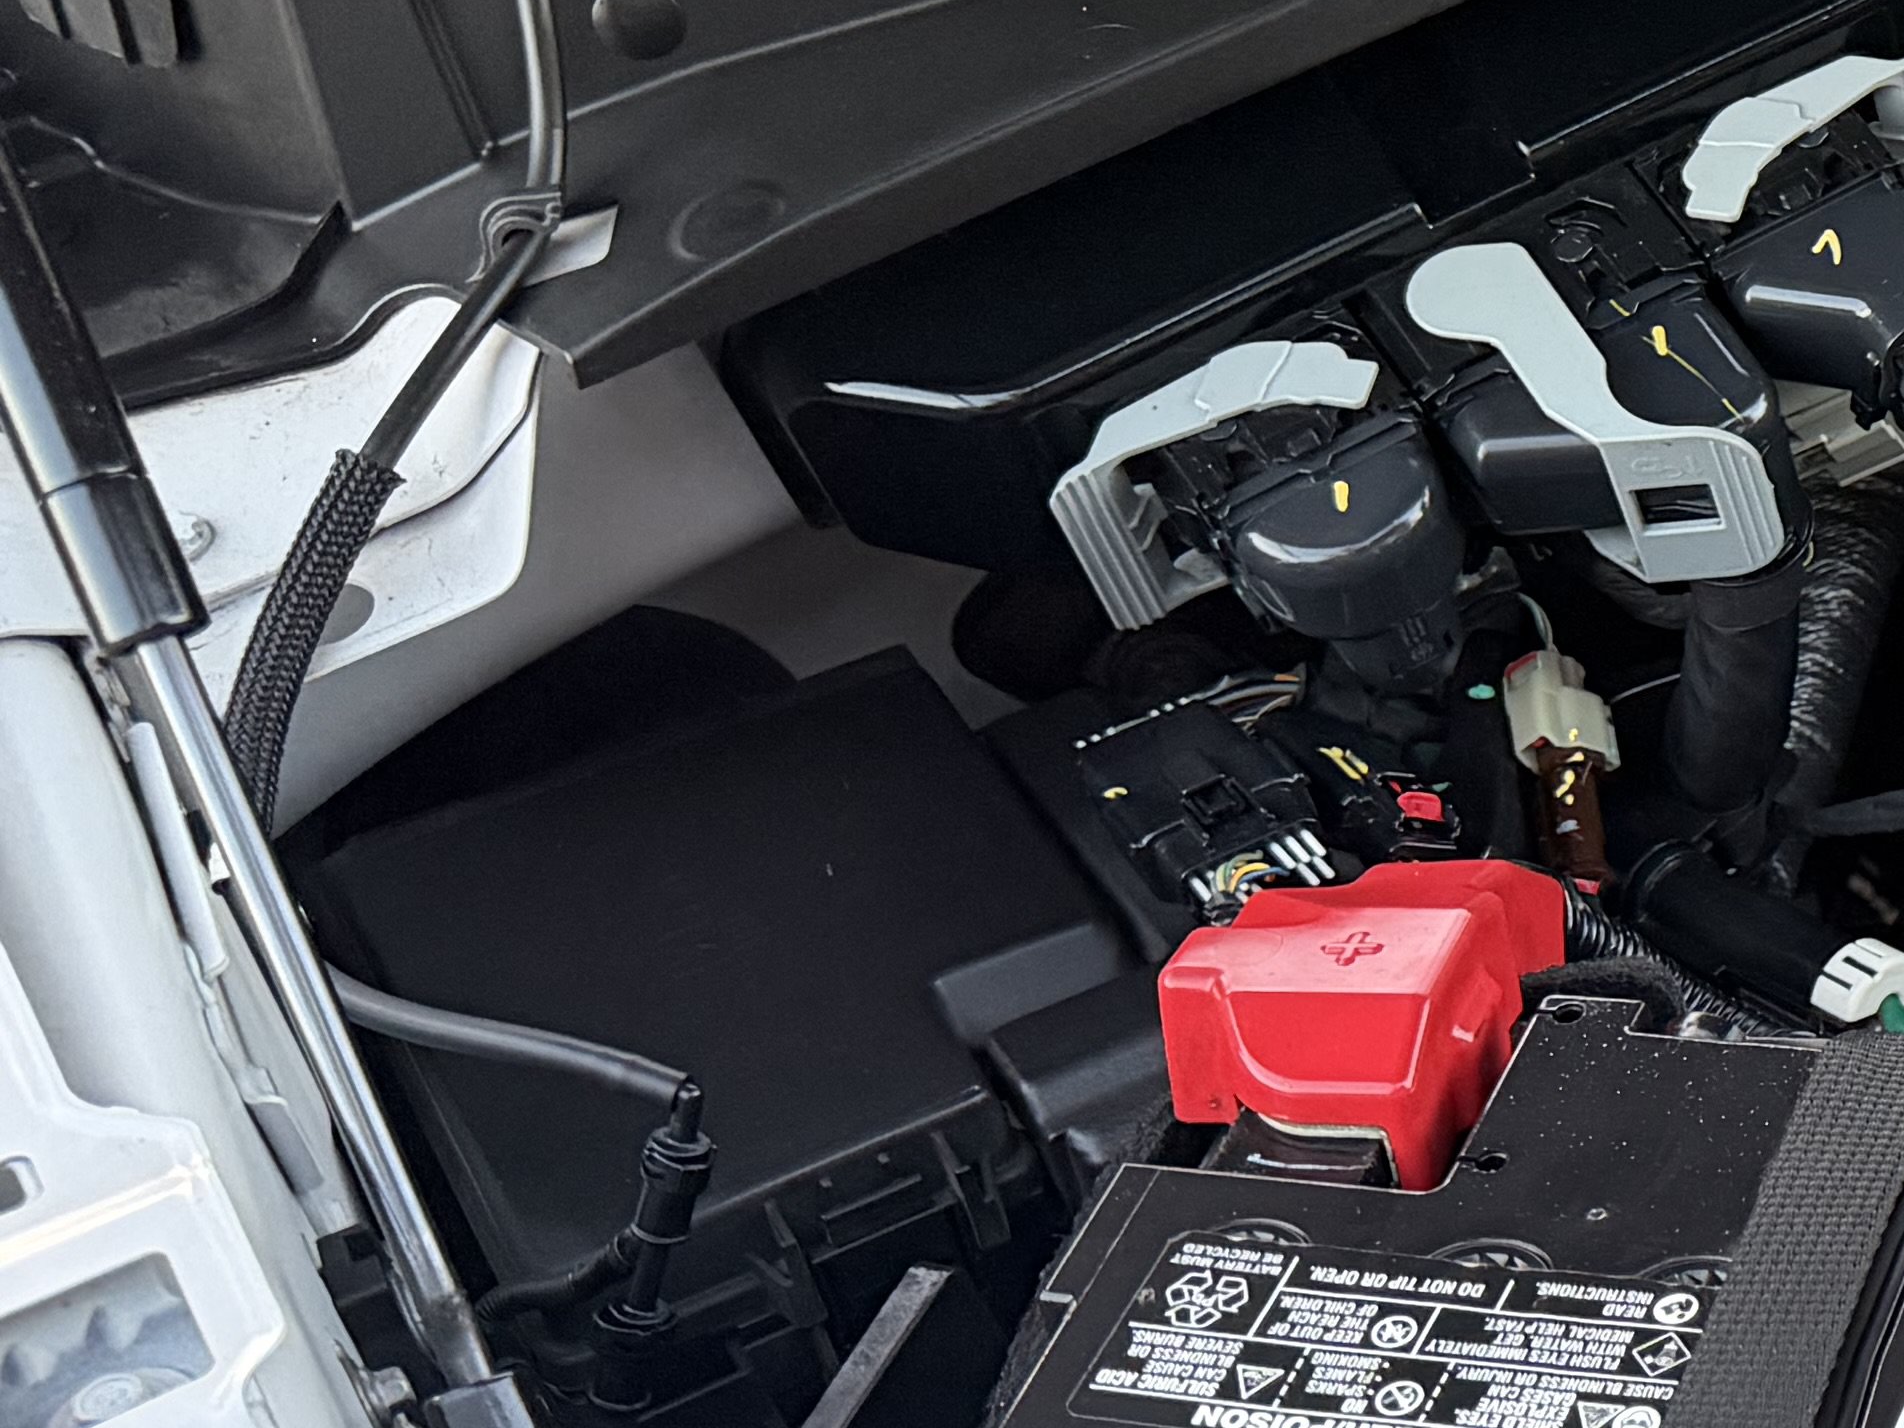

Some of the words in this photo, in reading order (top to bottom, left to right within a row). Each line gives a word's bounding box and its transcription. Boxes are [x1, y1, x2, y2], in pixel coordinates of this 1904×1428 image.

[1169, 1252, 1214, 1268] MUST
[1182, 1242, 1261, 1262] RECYCLED
[1261, 1252, 1284, 1264] BE
[1213, 1258, 1282, 1276] BATTERY
[1309, 1265, 1360, 1285] OPEN.
[1359, 1271, 1388, 1288] OR
[1387, 1275, 1417, 1291] TIP
[1417, 1277, 1457, 1295] NOT
[1457, 1281, 1486, 1298] DO
[1535, 1281, 1654, 1305] INSTRUCTIONS.
[1279, 1295, 1356, 1315] CHILDREN.
[1355, 1303, 1378, 1318] OF
[1601, 1302, 1647, 1319] READ
[1286, 1309, 1340, 1327] REACH
[1338, 1315, 1369, 1331] THE
[1483, 1316, 1525, 1333] FAST.
[1266, 1321, 1291, 1336] OF
[1288, 1324, 1323, 1340] OUT
[1322, 1328, 1364, 1344] KEEP
[1523, 1320, 1566, 1337] HELP
[1568, 1324, 1634, 1344] MEDICAL
[1131, 1329, 1185, 1348] BURNS.
[1184, 1336, 1243, 1354] SEVERE
[1492, 1332, 1525, 1346] GET
[1529, 1334, 1584, 1353] WATER.
[1126, 1342, 1151, 1358] OR
[1151, 1346, 1235, 1368] BLINDNESS
[1423, 1338, 1528, 1361] IMMEDIATELY
[1527, 1348, 1570, 1366] EYES
[1585, 1340, 1626, 1357] WITH
[1142, 1359, 1194, 1377] CAUSE
[1310, 1351, 1382, 1370] SMOKING
[1568, 1353, 1620, 1370] FLUSH
[1094, 1368, 1139, 1387] ACID
[1193, 1365, 1227, 1381] CAN
[1311, 1365, 1374, 1384] FLAMES
[1455, 1365, 1514, 1384] INJURY.
[1513, 1371, 1537, 1386] OR
[1136, 1373, 1219, 1397] SULFURIC
[1304, 1379, 1367, 1398] SPARKS
[1486, 1383, 1520, 1399] CAN
[1537, 1374, 1623, 1395] BLINDNESS
[1622, 1382, 1674, 1400] CAUSE
[1340, 1397, 1368, 1414] NO
[1519, 1387, 1576, 1407] GASES
[1475, 1396, 1570, 1421] EXPLOSIVE
[1453, 1408, 1502, 1428] EYES.
